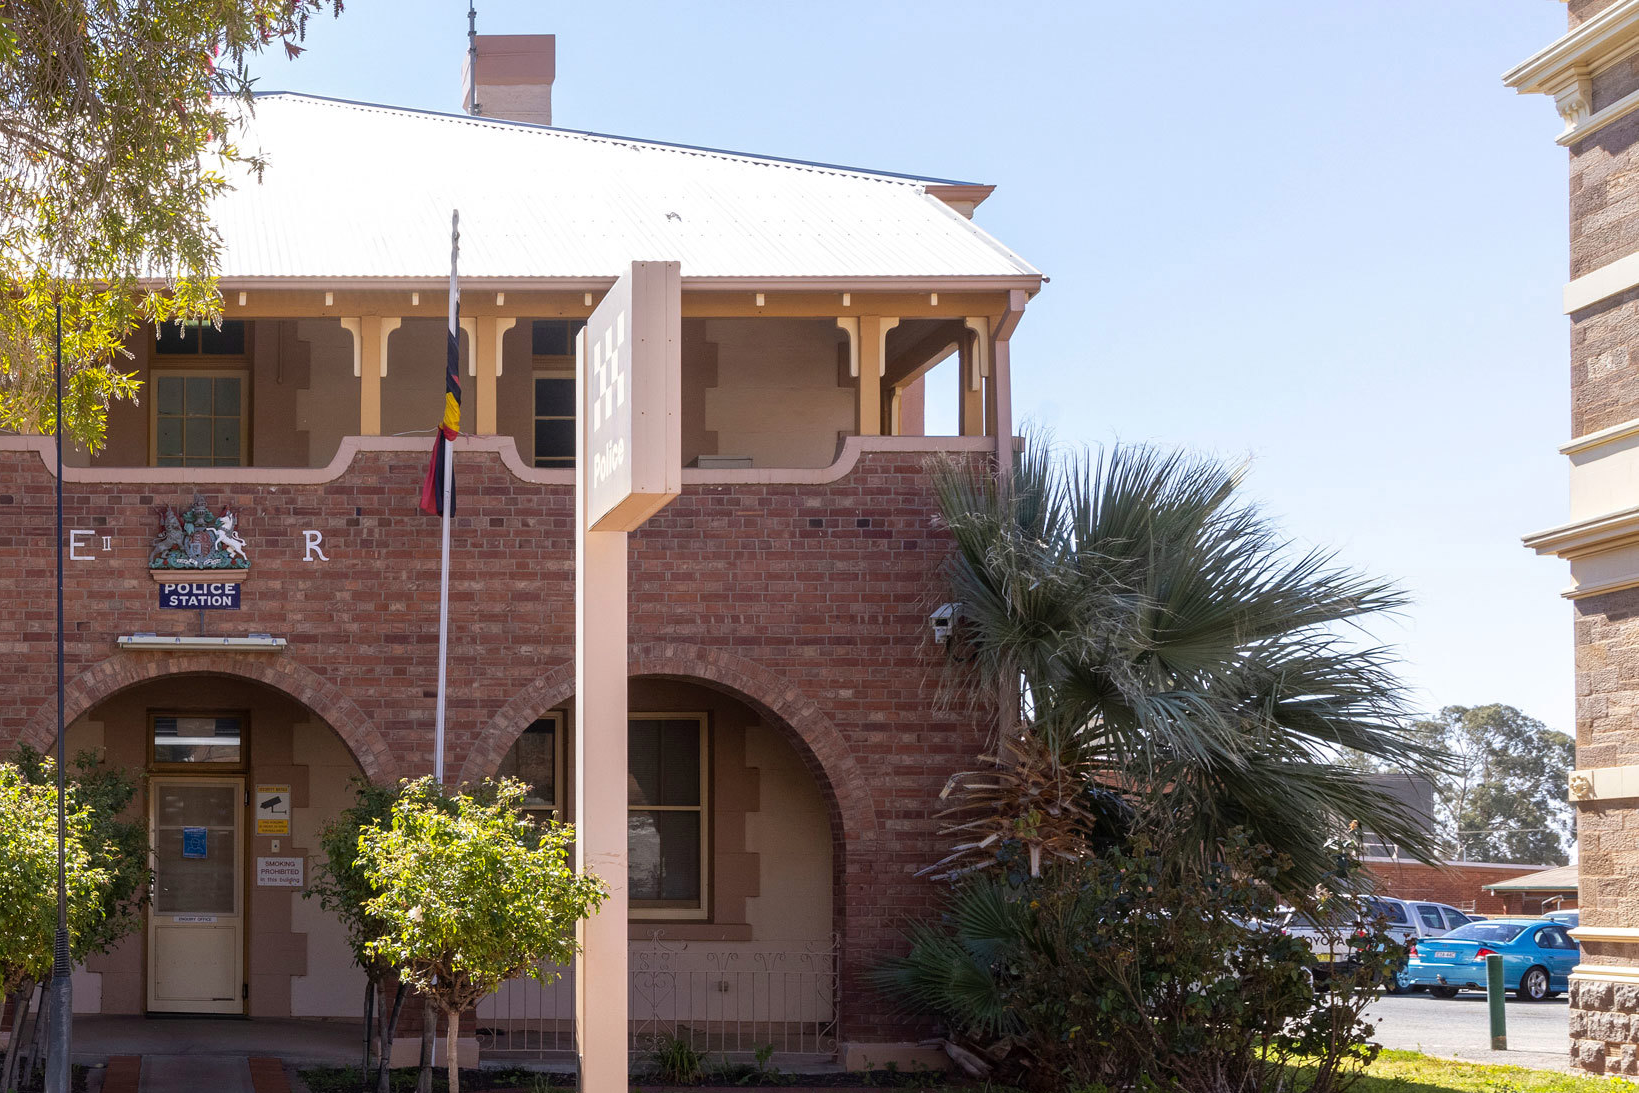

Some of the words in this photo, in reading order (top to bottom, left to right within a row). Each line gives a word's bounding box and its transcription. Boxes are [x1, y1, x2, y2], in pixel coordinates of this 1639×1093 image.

[594, 437, 624, 489] Police
[69, 529, 96, 561] E
[302, 530, 329, 561] R
[164, 583, 236, 594] POLICE
[169, 595, 232, 606] STATION
